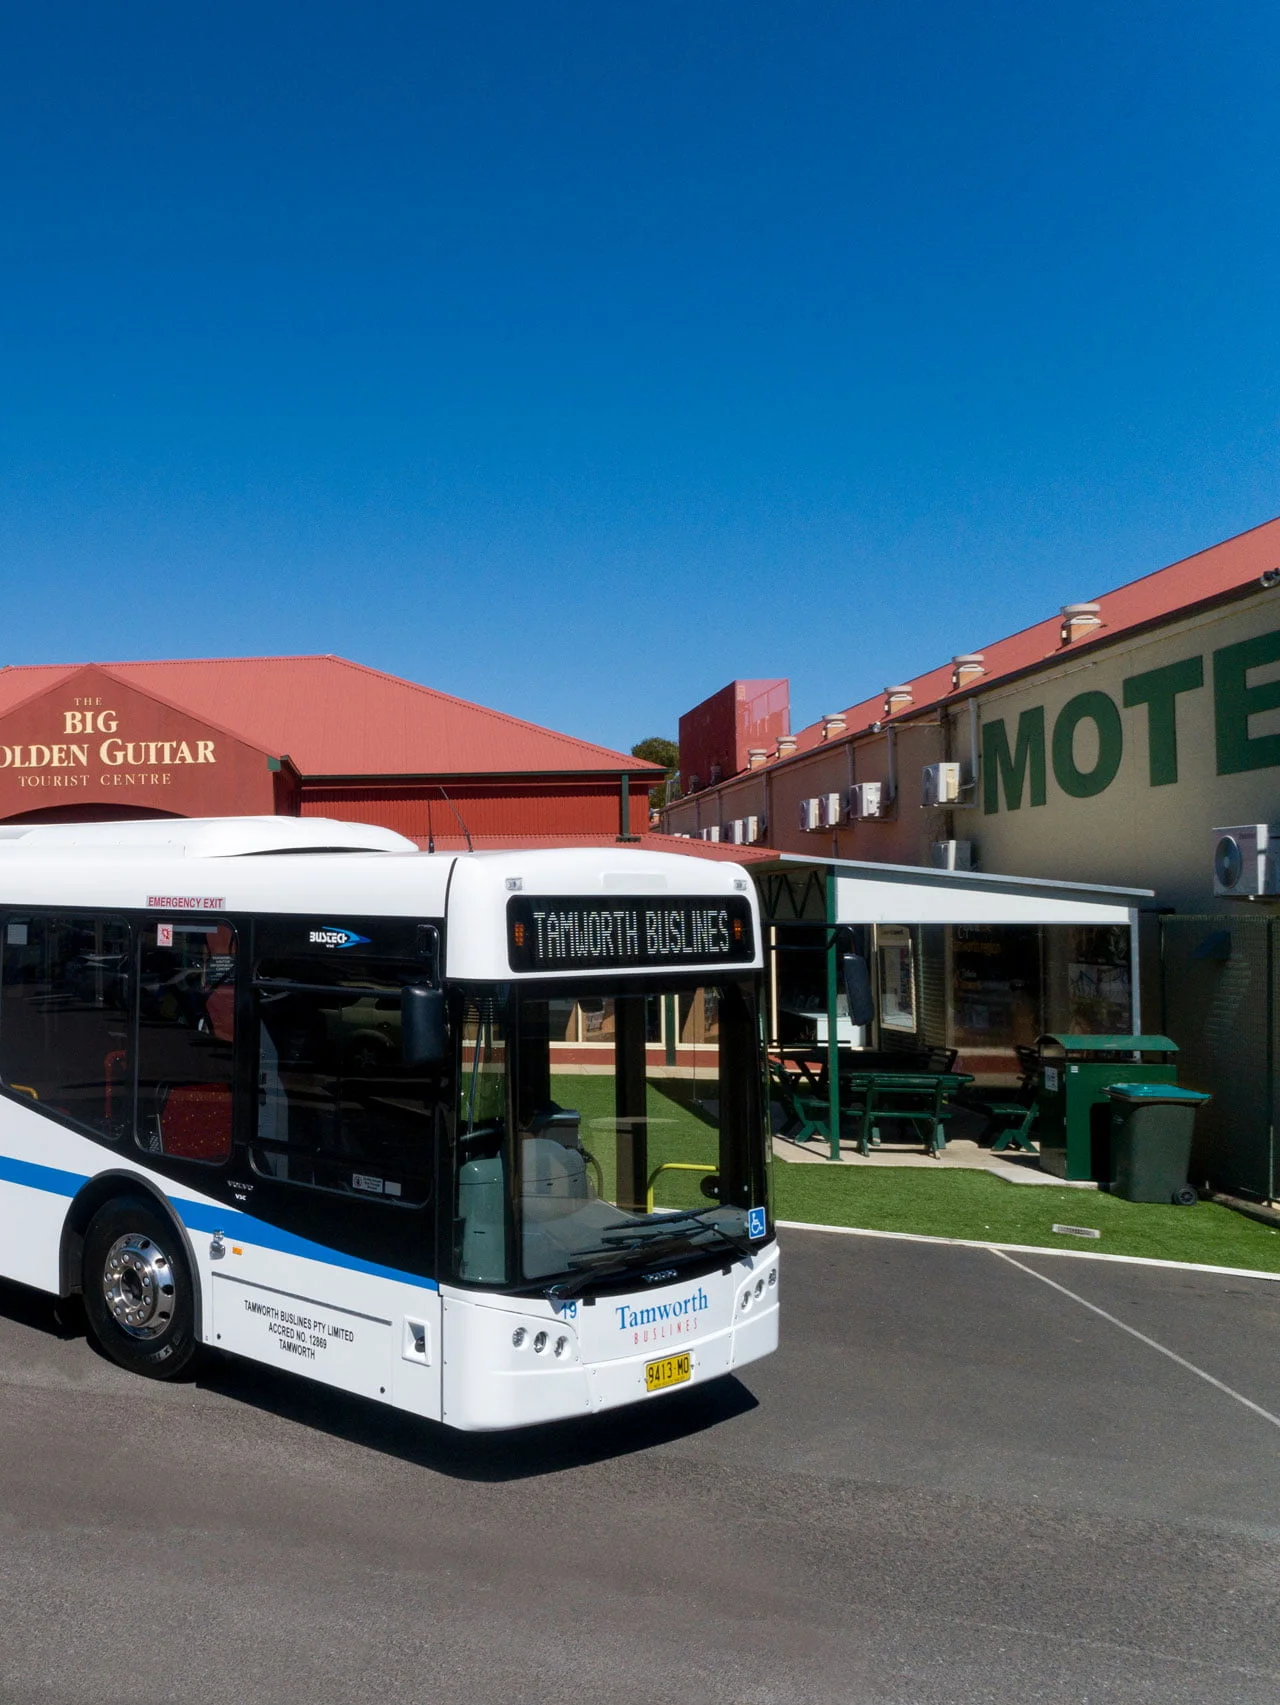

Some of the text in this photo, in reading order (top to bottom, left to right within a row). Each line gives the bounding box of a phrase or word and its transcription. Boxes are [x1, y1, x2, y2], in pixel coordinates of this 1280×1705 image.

[74, 697, 103, 706] THE
[64, 710, 119, 735] BIG
[99, 738, 217, 766] GUITAR
[18, 773, 172, 788] TOURIST CENTRE
[148, 896, 223, 909] EMERGENCY EXIT
[533, 910, 729, 958] TAMWORTH BUSLINES
[244, 1300, 354, 1342] TAMWORTH BUSLINES PTY LIMITED
[615, 1287, 708, 1330] Tamworth
[268, 1322, 295, 1339] ACCRED
[634, 1317, 697, 1345] BUSLINES
[279, 1339, 316, 1360] TAMWORTH
